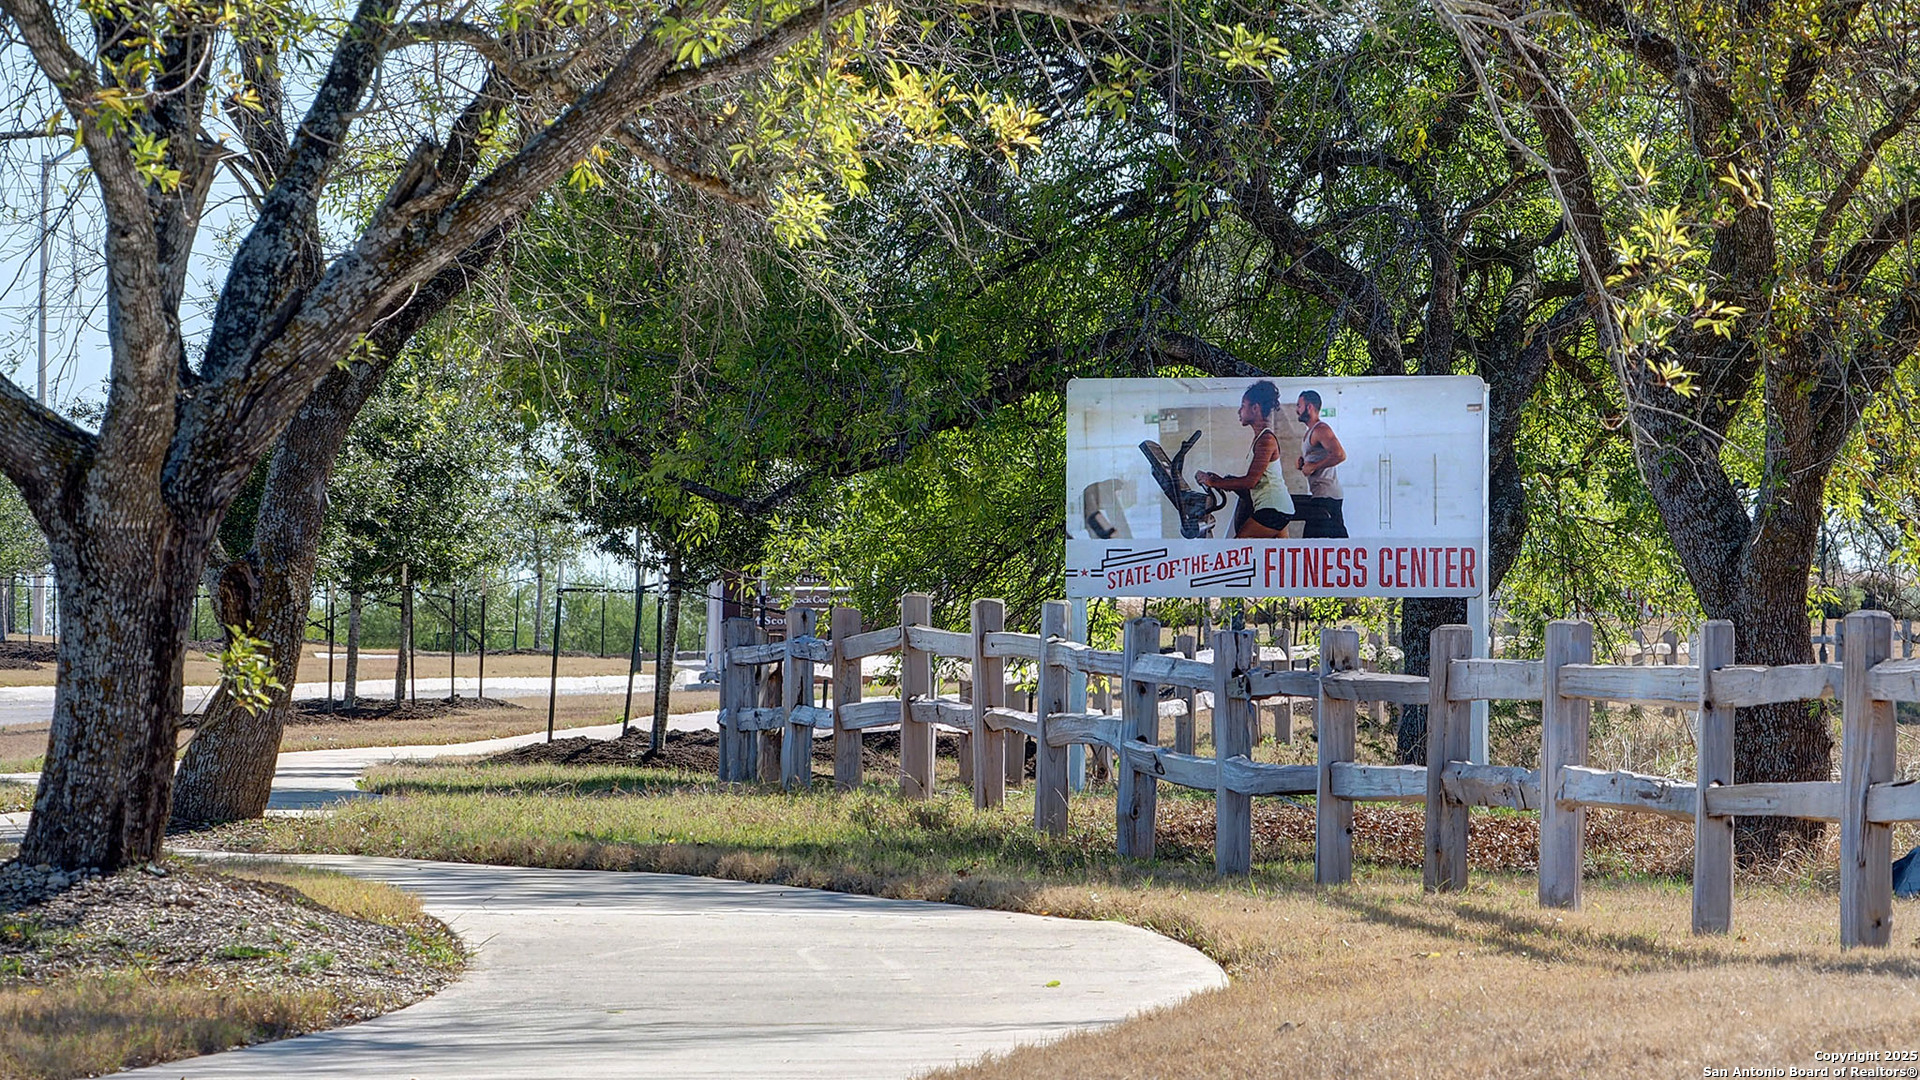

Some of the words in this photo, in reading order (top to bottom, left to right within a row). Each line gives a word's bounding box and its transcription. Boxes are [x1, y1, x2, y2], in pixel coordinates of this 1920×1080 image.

[1107, 546, 1253, 590] STATE-OF-THE-ART
[1264, 547, 1368, 588] FITNESS
[1378, 547, 1476, 588] CENTER
